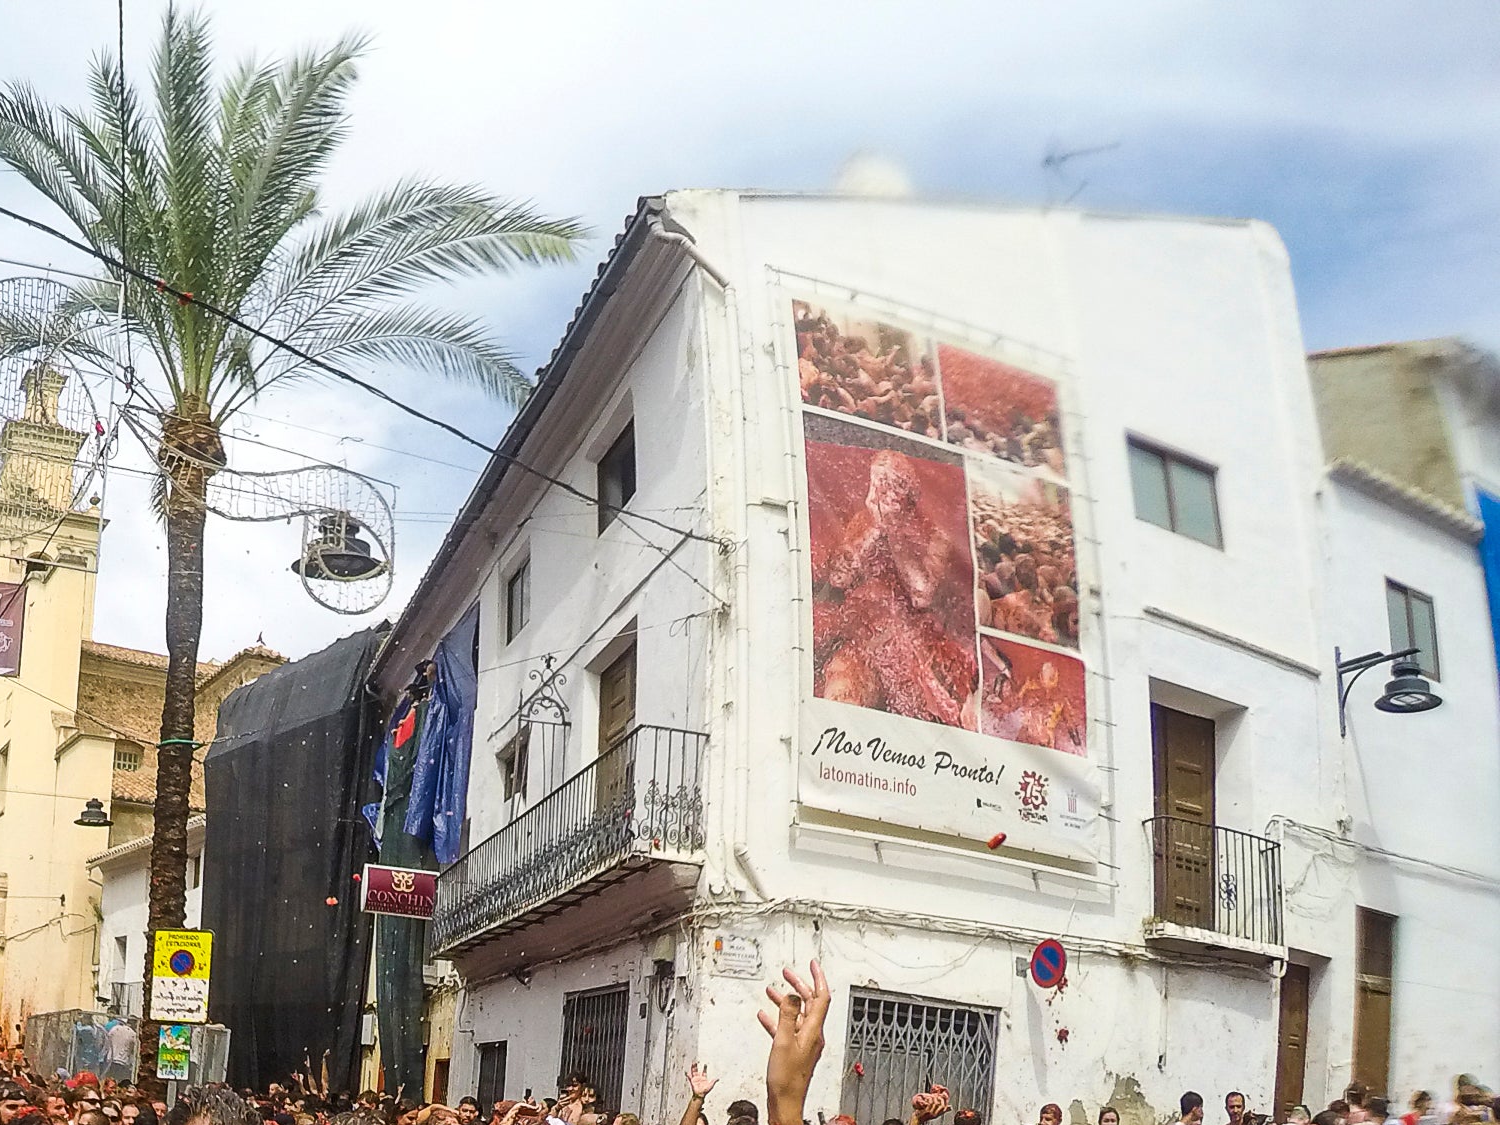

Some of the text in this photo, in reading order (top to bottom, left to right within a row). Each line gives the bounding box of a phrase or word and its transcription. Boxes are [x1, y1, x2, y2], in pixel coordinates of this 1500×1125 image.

[819, 761, 917, 796] latomatina.info
[866, 737, 927, 769] Vemos
[934, 751, 1005, 785] Pronto!
[1022, 776, 1043, 805] 75
